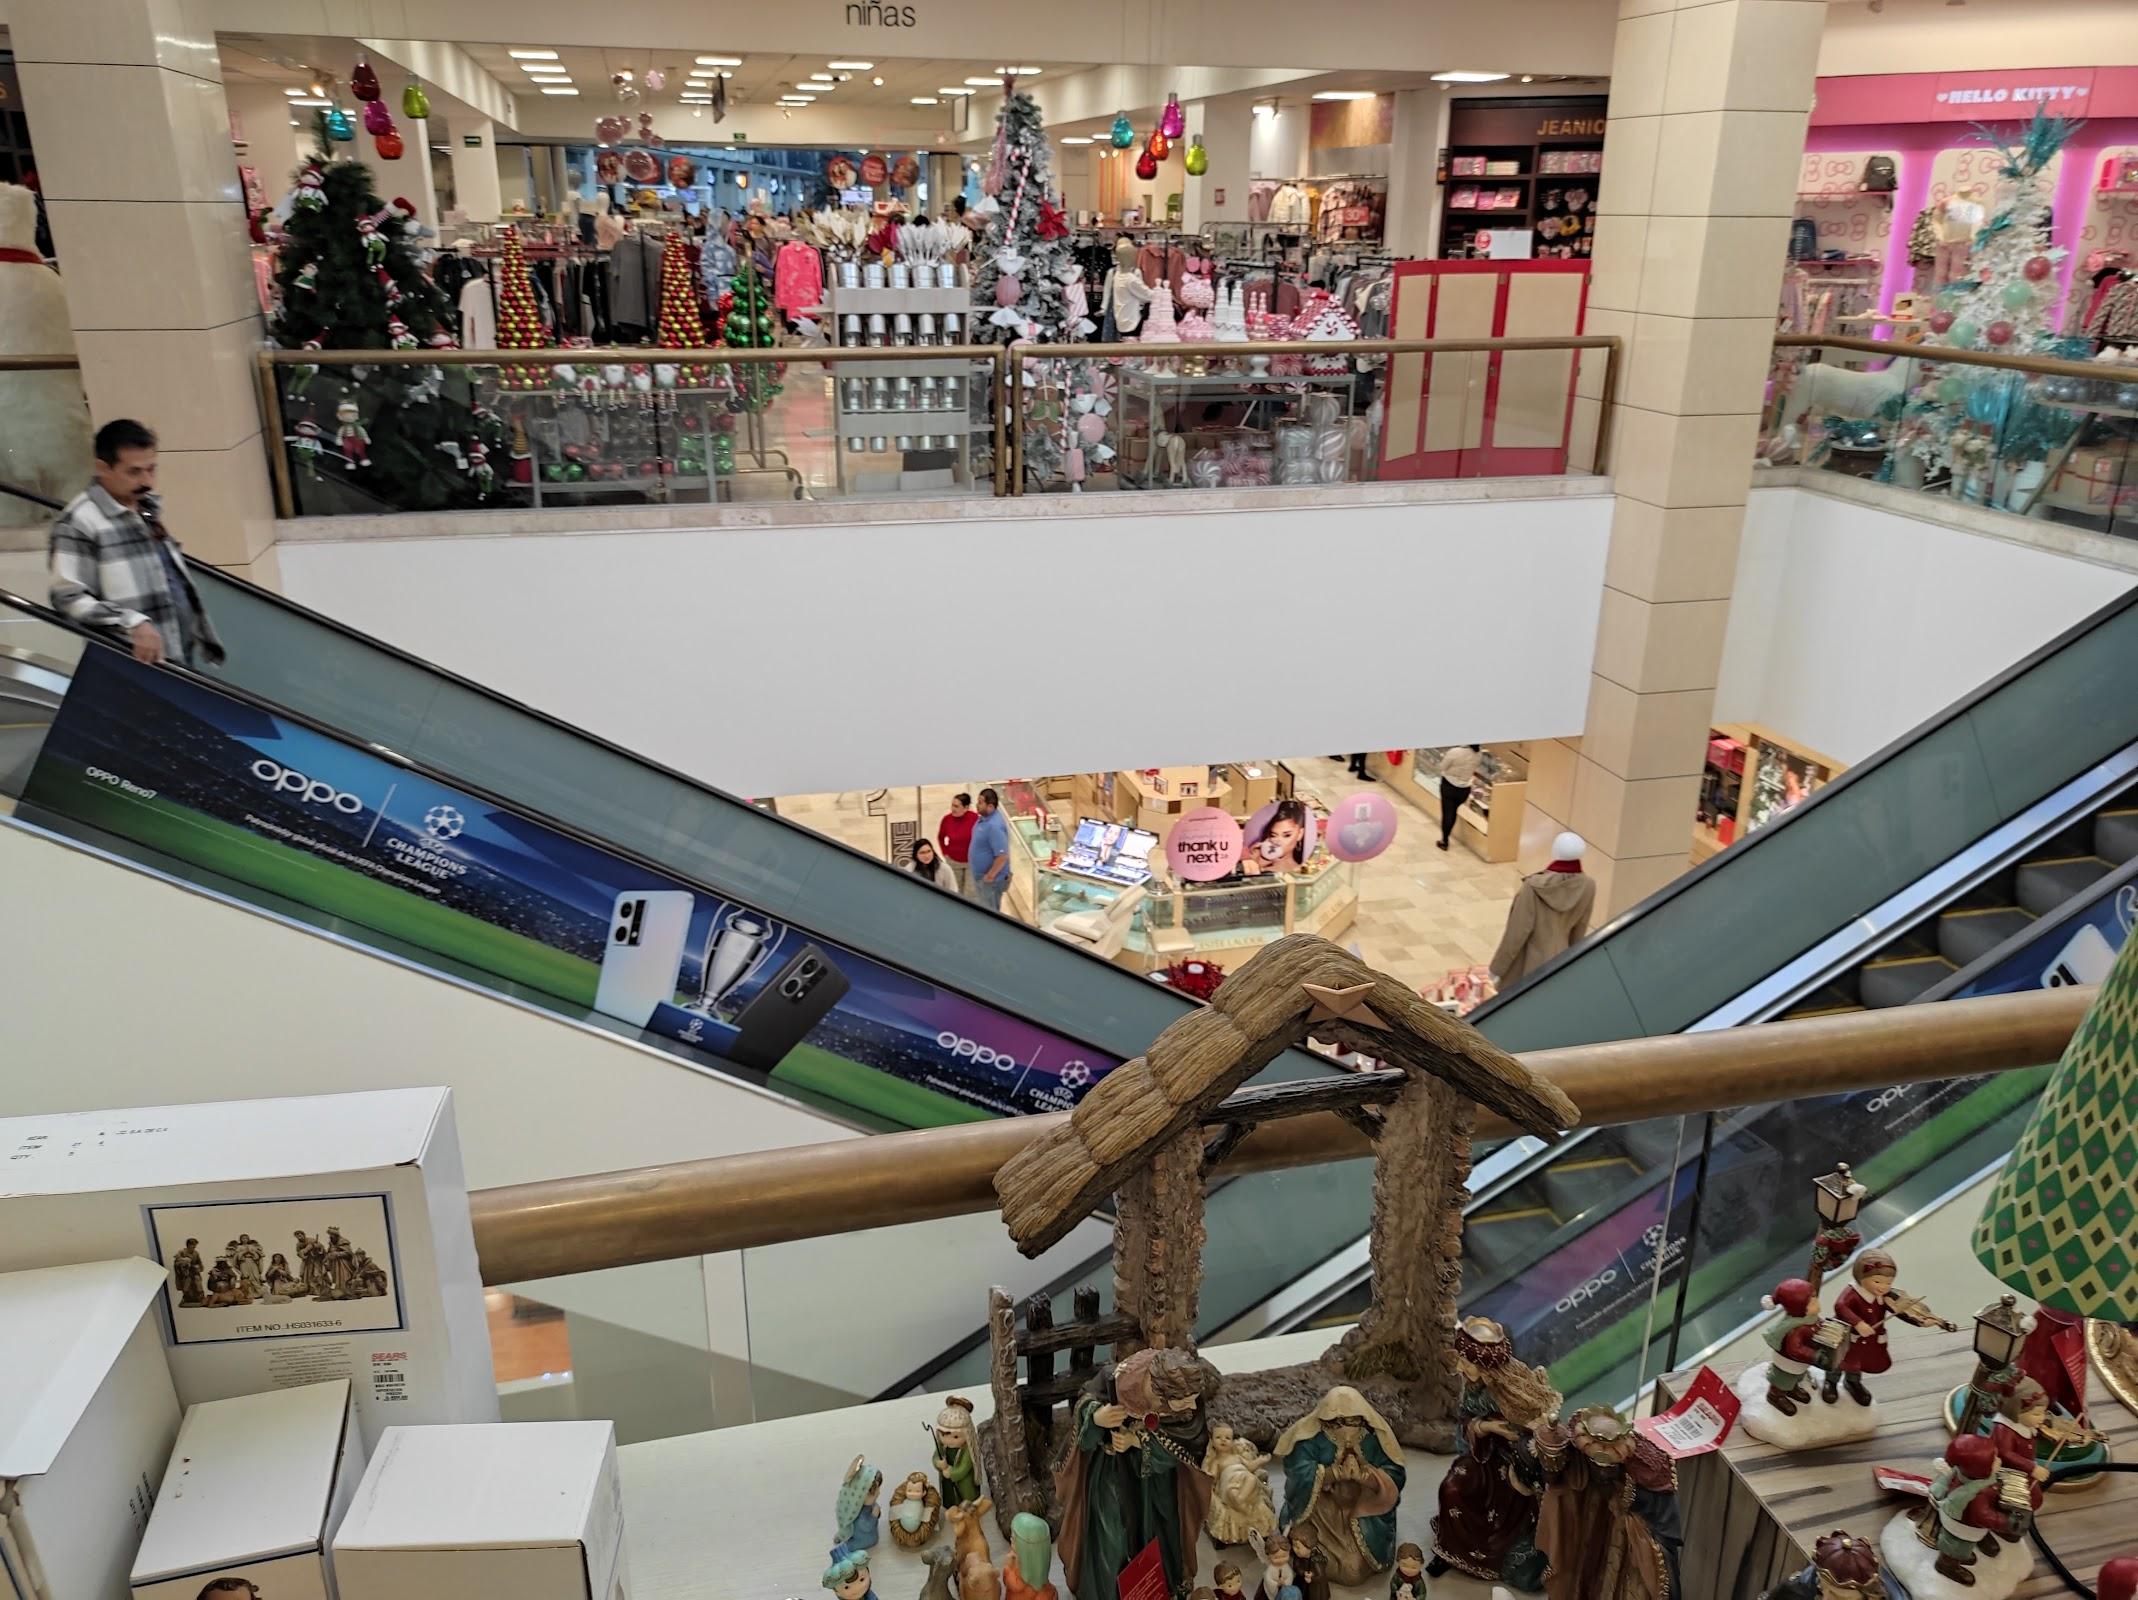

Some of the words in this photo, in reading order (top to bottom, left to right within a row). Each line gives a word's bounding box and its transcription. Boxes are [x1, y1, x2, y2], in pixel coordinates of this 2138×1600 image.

[846, 0, 916, 27] niñas
[1948, 88, 2009, 103] HELLO
[2012, 86, 2078, 102] KITTY
[86, 766, 120, 785] OPPO
[120, 780, 158, 799] Reno7
[251, 760, 363, 814] oppo
[386, 838, 467, 875] CHAMPIONS
[1178, 839, 1217, 853] thank
[1219, 840, 1229, 851] u
[1186, 851, 1219, 864] next
[394, 853, 450, 879] LEAGUE
[937, 1031, 1015, 1071] oppo
[1555, 1269, 1617, 1313] oppo
[236, 1325, 262, 1334] ITEM
[372, 1352, 408, 1360] SEARS
